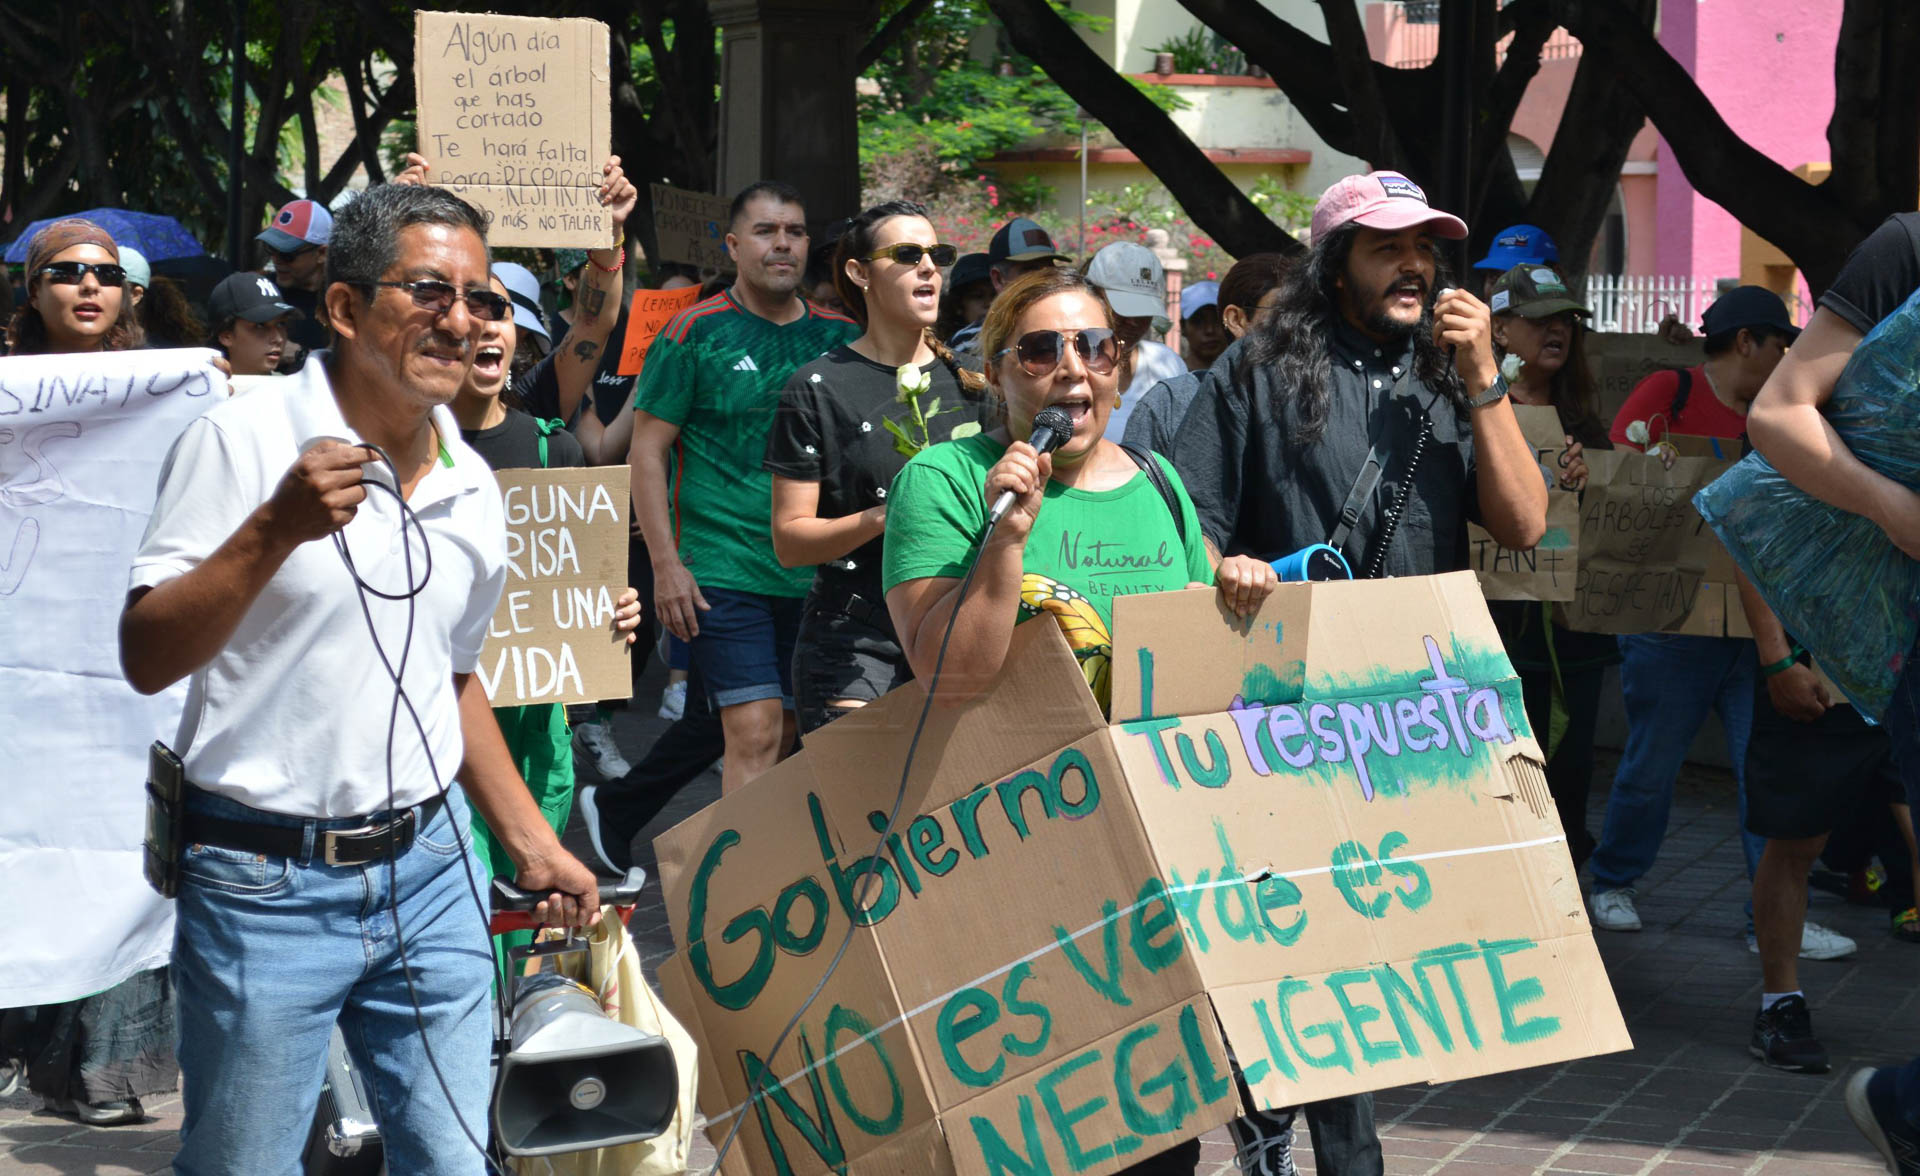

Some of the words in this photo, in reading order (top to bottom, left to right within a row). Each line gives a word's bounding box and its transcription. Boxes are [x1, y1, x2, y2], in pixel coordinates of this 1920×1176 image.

[443, 22, 517, 66] Algún
[527, 31, 560, 52] día
[452, 68, 473, 88] el
[488, 63, 546, 87] árbol
[454, 94, 481, 112] que
[496, 92, 536, 108] has
[456, 111, 543, 130] cortado
[432, 134, 461, 158] Te
[483, 137, 526, 157] hará
[537, 139, 587, 162] falta
[503, 165, 605, 208] RESPIRAR
[502, 210, 529, 231] más
[539, 214, 556, 231] NO
[559, 213, 602, 232] TALAR
[1642, 487, 1675, 506] LOS
[1058, 530, 1173, 570] Natural
[488, 590, 534, 639] LE
[552, 585, 616, 630] UNA
[475, 642, 584, 700] VIDA
[687, 747, 1101, 1013] Gobierno
[1121, 647, 1232, 791] Tu
[1228, 635, 1516, 802] respuesta
[737, 1003, 904, 1176] NO
[936, 960, 1052, 1087] es
[1329, 830, 1433, 919] es
